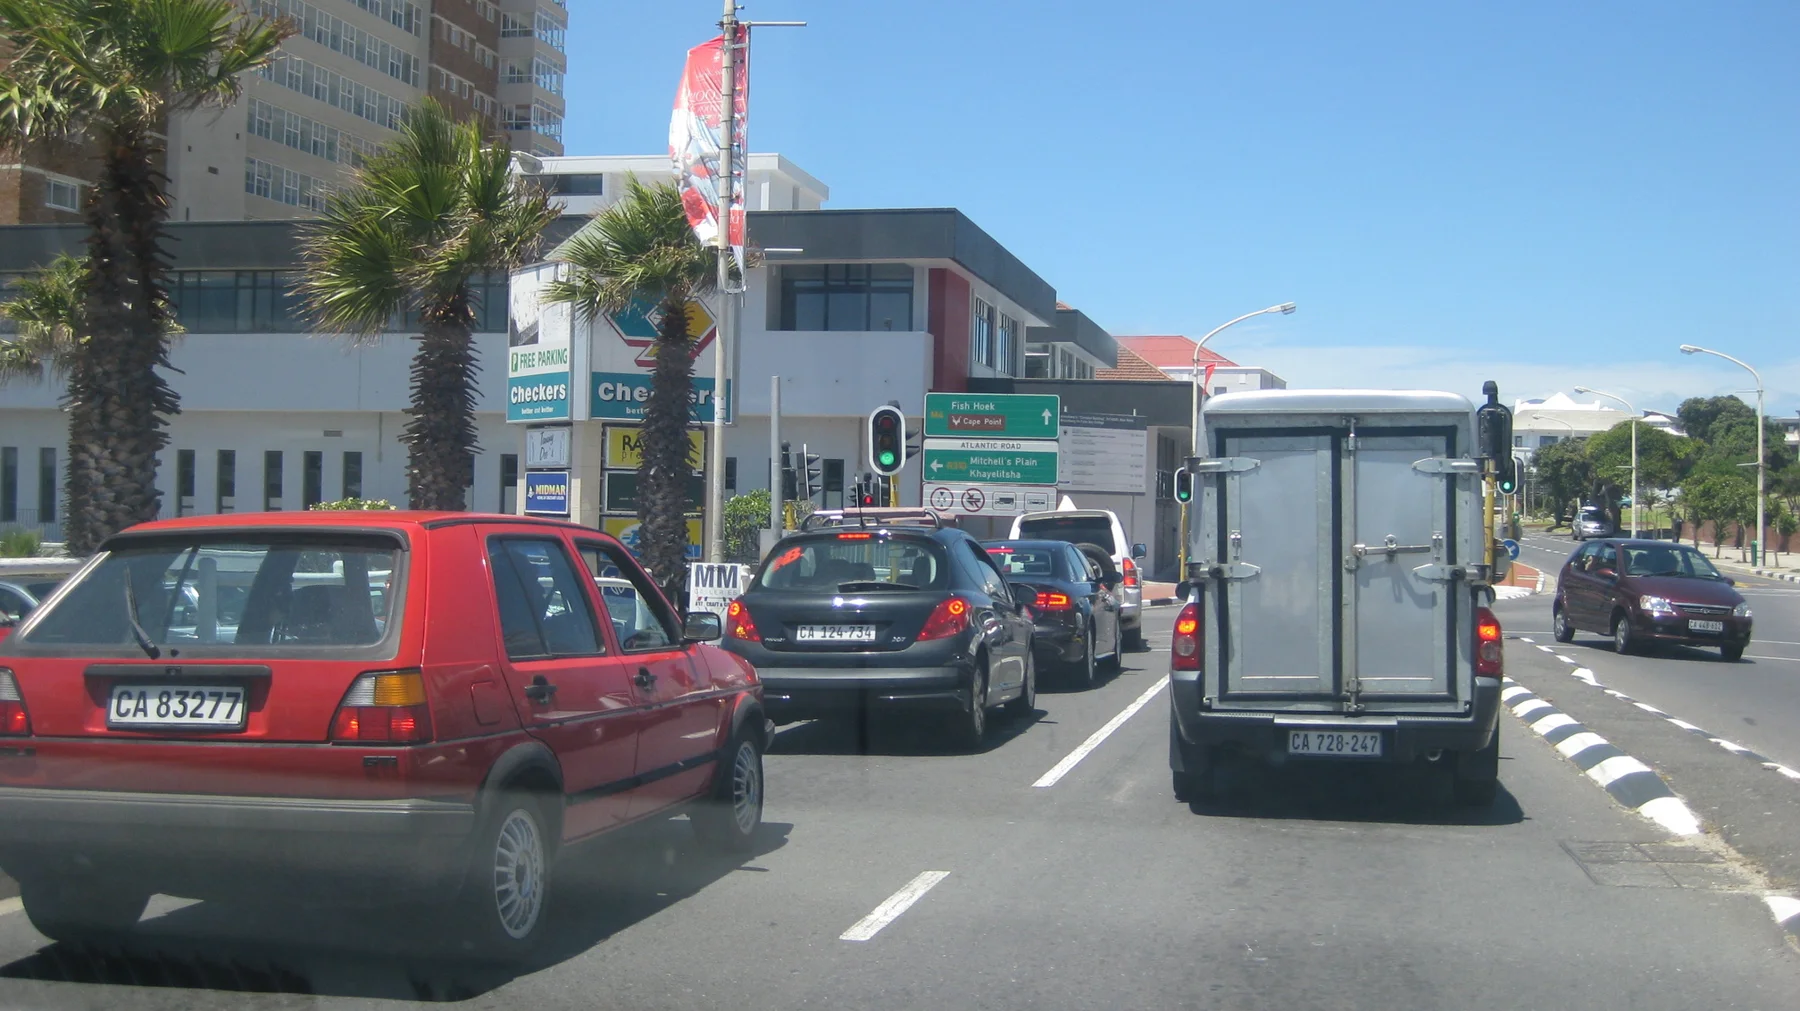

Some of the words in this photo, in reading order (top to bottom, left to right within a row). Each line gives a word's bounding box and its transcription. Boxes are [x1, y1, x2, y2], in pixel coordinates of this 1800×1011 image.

[520, 352, 536, 369] FREE
[538, 348, 568, 367] PARKING
[511, 383, 566, 404] Checkers
[951, 401, 970, 410] Fish
[973, 402, 995, 411] Hoek
[963, 417, 981, 427] Cape
[983, 417, 1002, 426] Point
[1000, 442, 1022, 450] ROAD
[969, 456, 1012, 466] Mitchell's
[1015, 457, 1037, 466] Plain
[969, 470, 1021, 480] Khayelitsha
[535, 484, 567, 496] MIDMAR
[695, 564, 738, 588] MM
[799, 626, 814, 639] CA
[821, 626, 871, 639] 124-734
[116, 690, 148, 718] CA
[156, 690, 241, 719] 83277
[1292, 733, 1310, 751] CA
[1317, 734, 1379, 753] 728-247
